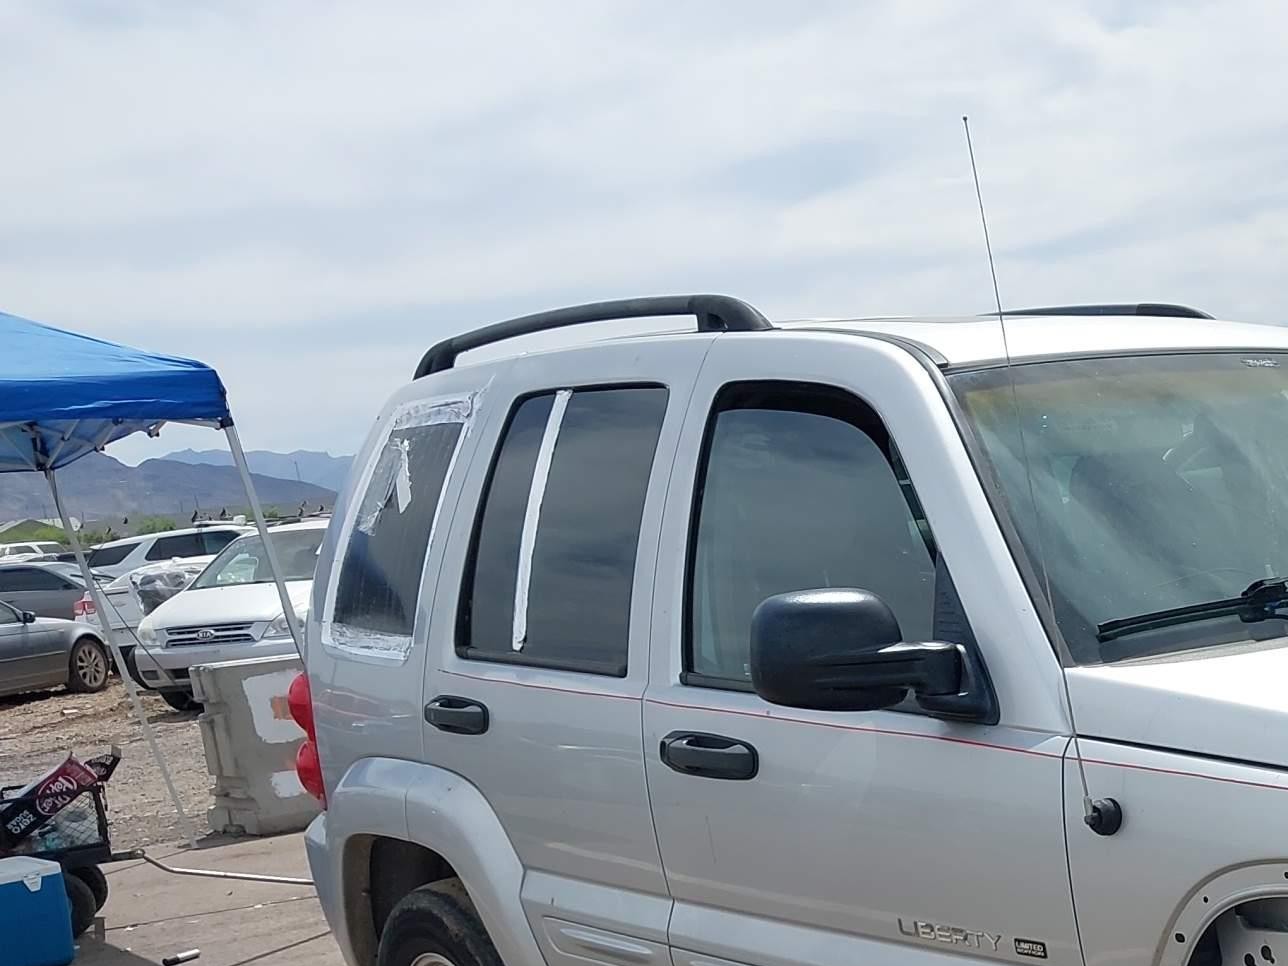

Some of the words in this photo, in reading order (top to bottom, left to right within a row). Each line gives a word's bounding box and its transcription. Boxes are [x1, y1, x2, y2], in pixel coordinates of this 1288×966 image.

[198, 630, 212, 639] KIA
[897, 918, 1002, 951] LIBERTY
[1015, 940, 1044, 952] LIMITED
